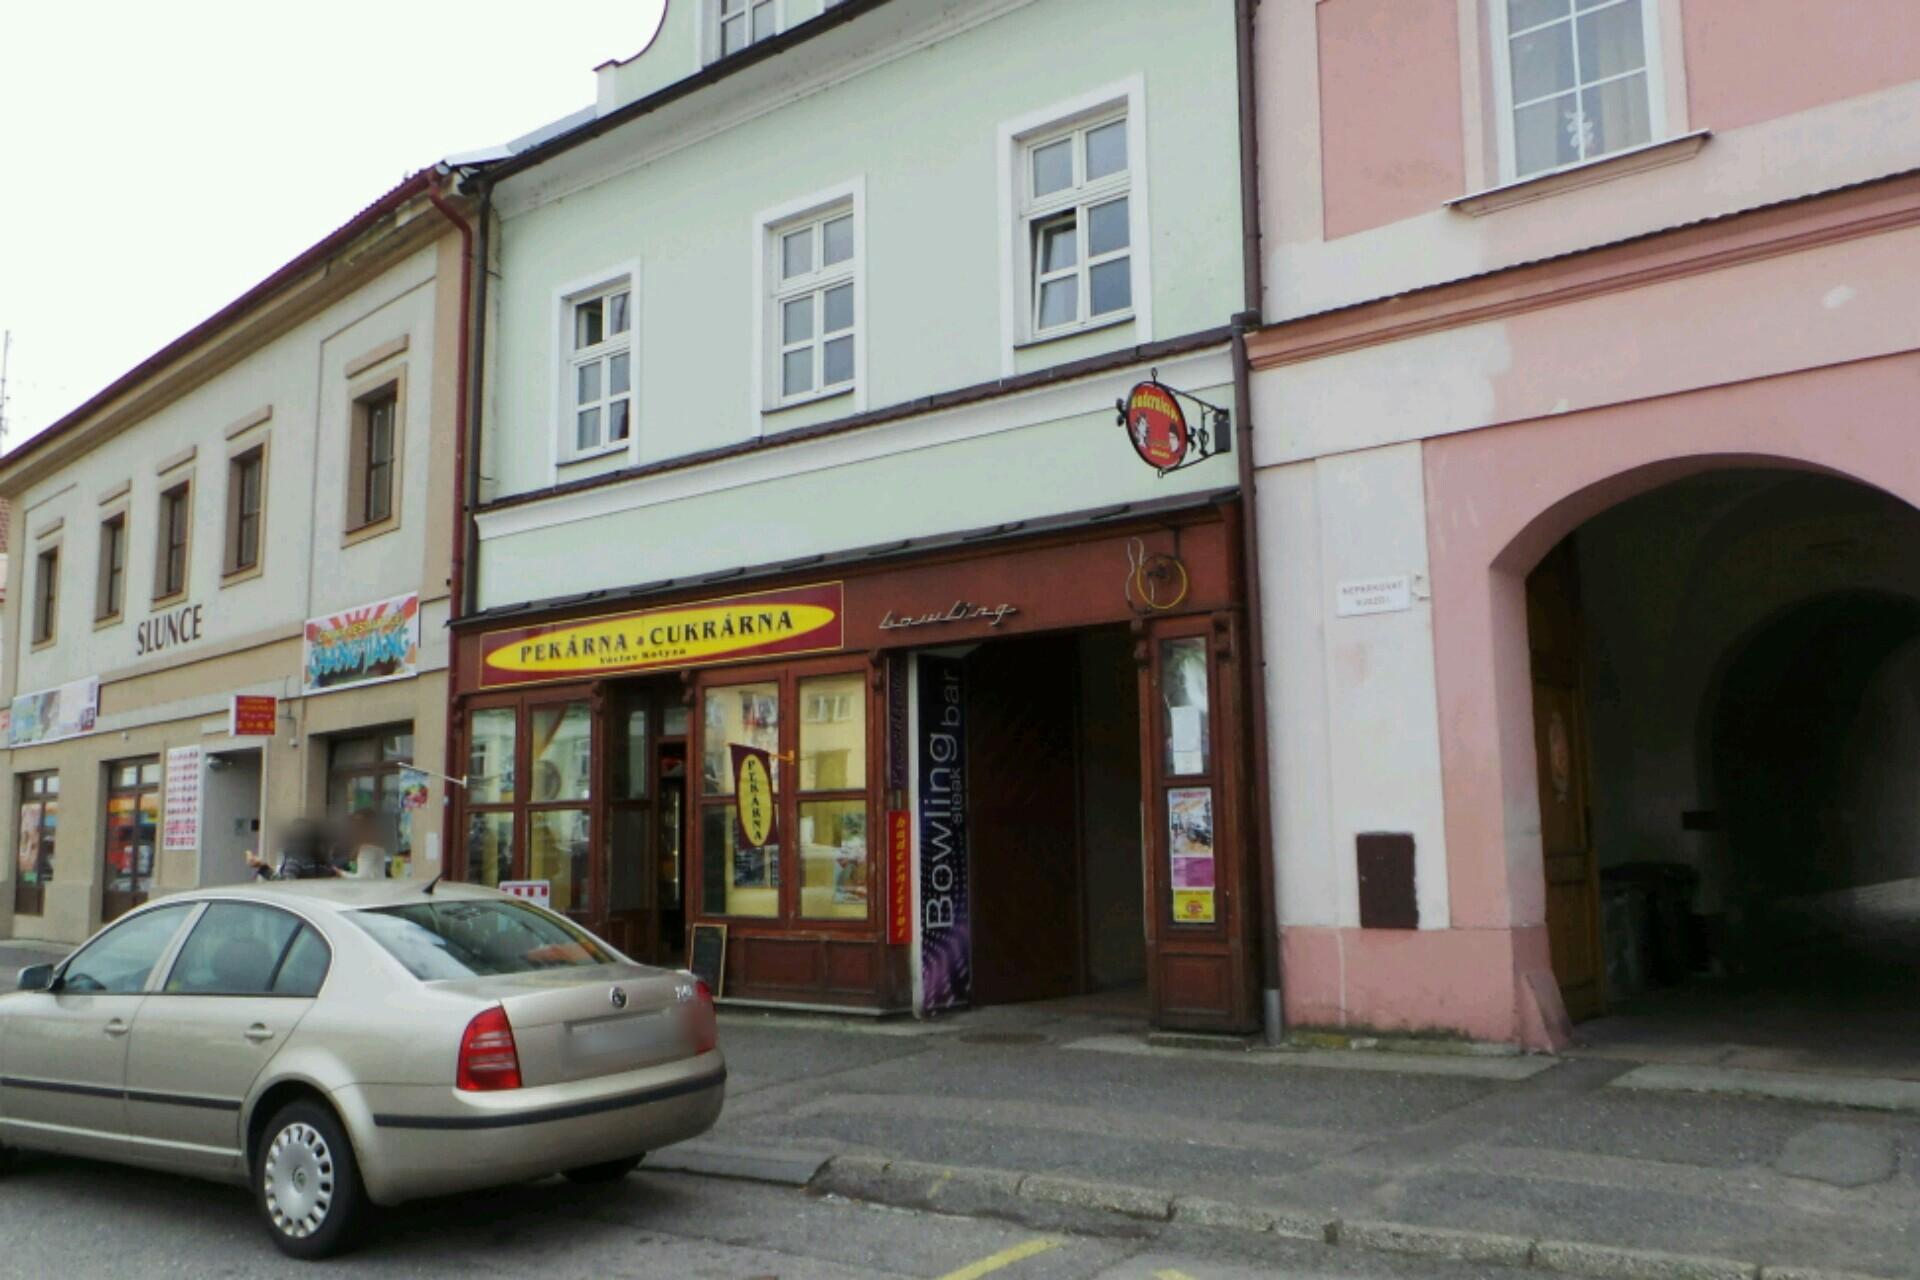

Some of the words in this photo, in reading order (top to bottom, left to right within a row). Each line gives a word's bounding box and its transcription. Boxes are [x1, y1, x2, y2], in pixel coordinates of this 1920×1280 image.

[137, 604, 202, 656] SLUNCE
[520, 633, 628, 664] PEKÁRNA
[650, 609, 794, 646] CUKRÁRNA
[879, 599, 1016, 627] bowling
[941, 667, 961, 727] bar
[950, 766, 963, 824] steak
[924, 732, 958, 930] Bowling
